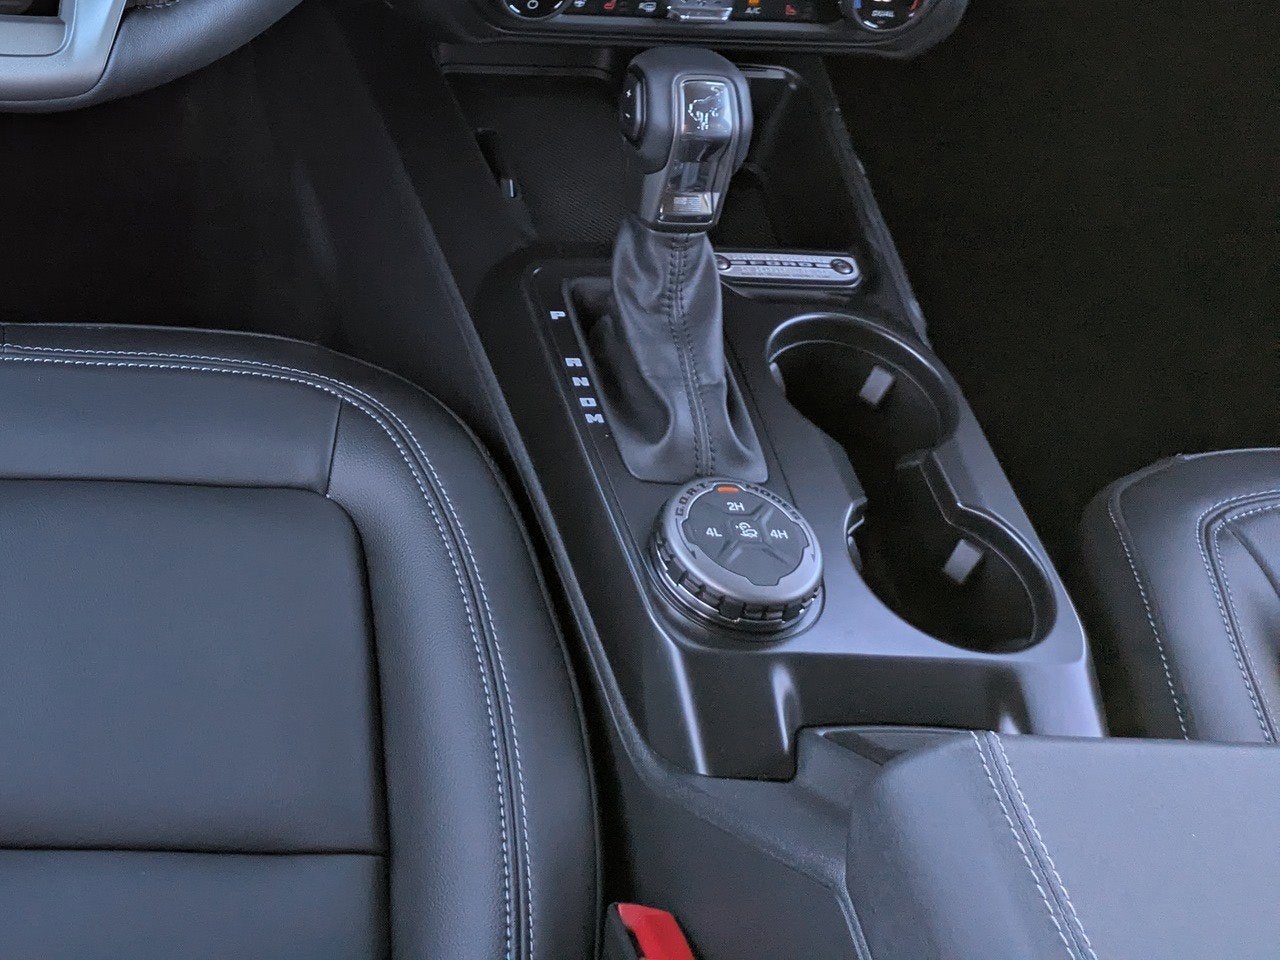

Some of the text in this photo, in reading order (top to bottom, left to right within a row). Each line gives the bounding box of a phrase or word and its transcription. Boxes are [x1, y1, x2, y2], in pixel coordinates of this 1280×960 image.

[744, 7, 761, 16] A/C
[549, 310, 566, 320] P
[572, 376, 590, 387] N
[579, 397, 597, 407] D
[585, 413, 605, 424] M
[726, 501, 745, 512] 2H
[705, 527, 723, 538] 4L
[770, 529, 789, 539] 4H
